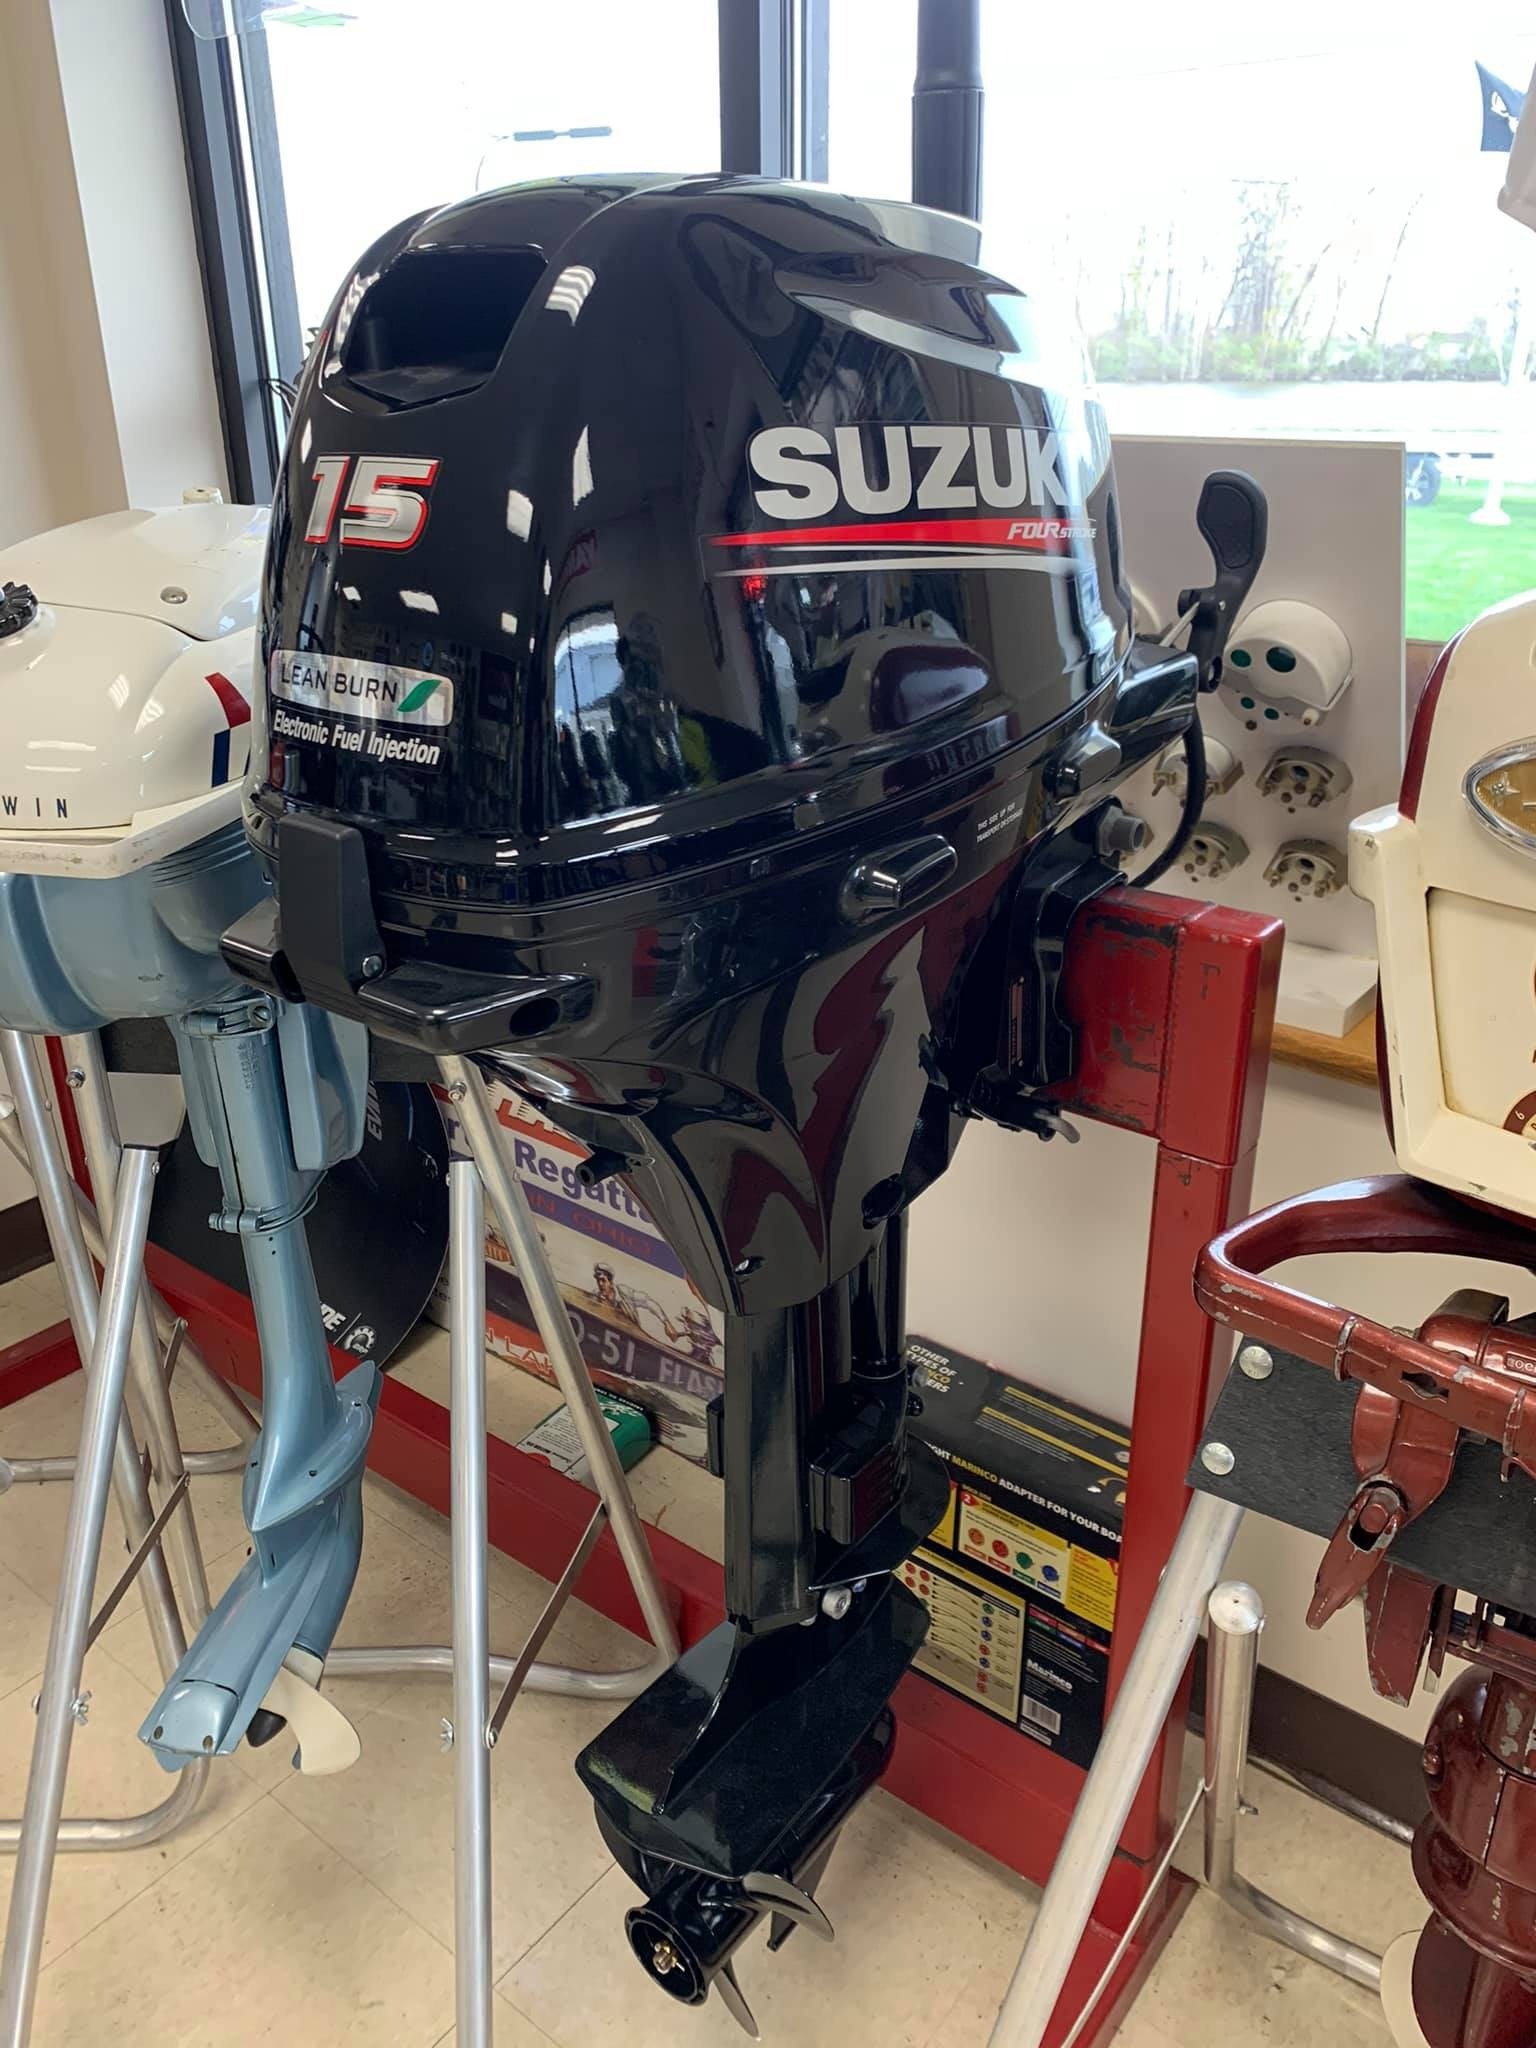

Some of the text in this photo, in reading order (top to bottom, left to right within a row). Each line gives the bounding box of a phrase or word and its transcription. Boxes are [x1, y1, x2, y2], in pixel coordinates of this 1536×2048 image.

[749, 426, 1090, 519] SUZUK
[304, 455, 441, 550] 15
[1008, 522, 1061, 540] FOUR
[281, 663, 398, 703] LEAN BURN
[273, 709, 441, 766] Electronic Fuel Injection
[911, 1345, 950, 1366] OTHER
[939, 1367, 958, 1377] OF
[952, 1456, 998, 1483] MARINCO
[999, 1478, 1046, 1507] ADAPTER
[1046, 1500, 1069, 1518] FOR
[1069, 1511, 1100, 1533] YOUR
